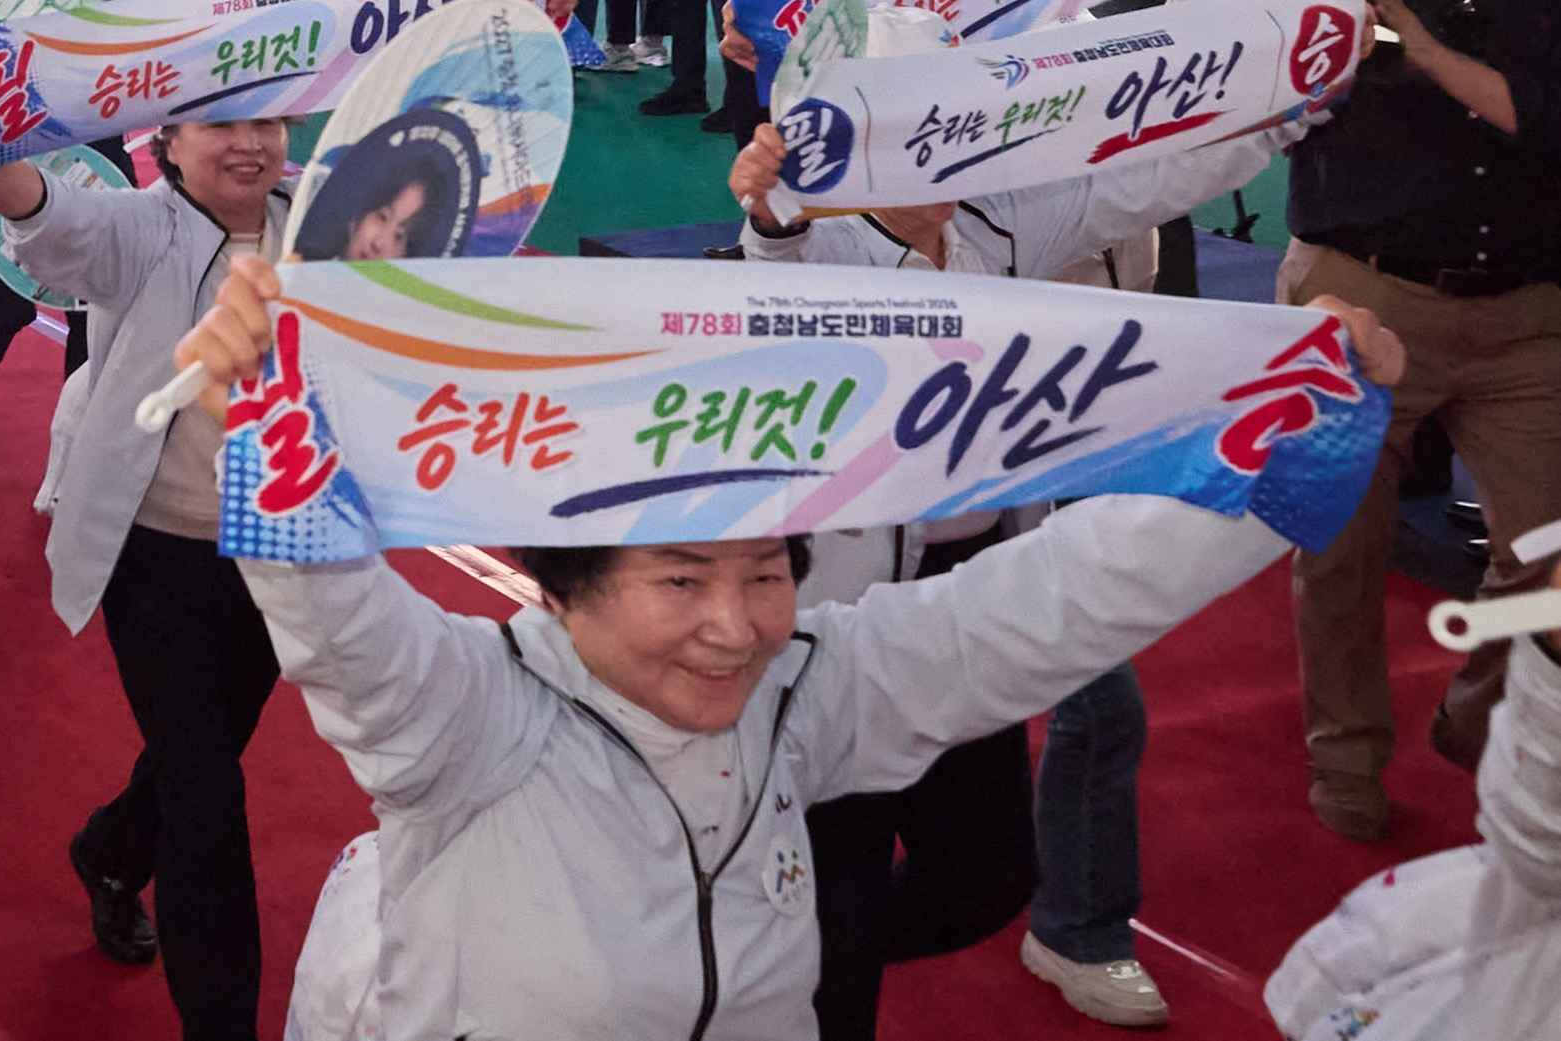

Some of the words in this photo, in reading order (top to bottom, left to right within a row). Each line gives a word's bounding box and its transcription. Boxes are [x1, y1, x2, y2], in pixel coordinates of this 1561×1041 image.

[89, 62, 180, 119] 승리는
[213, 21, 322, 82] 우리것!
[1033, 53, 1075, 70] 제78회
[1074, 33, 1175, 63] 충청남도민체육대회
[782, 104, 847, 193] 필
[904, 104, 989, 168] 승리는
[994, 85, 1087, 146] 우리것!
[1105, 41, 1245, 139] 아산!
[1297, 11, 1346, 90] 승
[661, 311, 742, 337] 제78회
[747, 313, 964, 339] 충청남도민체육대회
[225, 311, 342, 514] 필
[397, 383, 579, 491] 승리는
[635, 376, 857, 468] 우리것!
[894, 319, 1160, 479] 아산
[1215, 315, 1365, 477] 승
